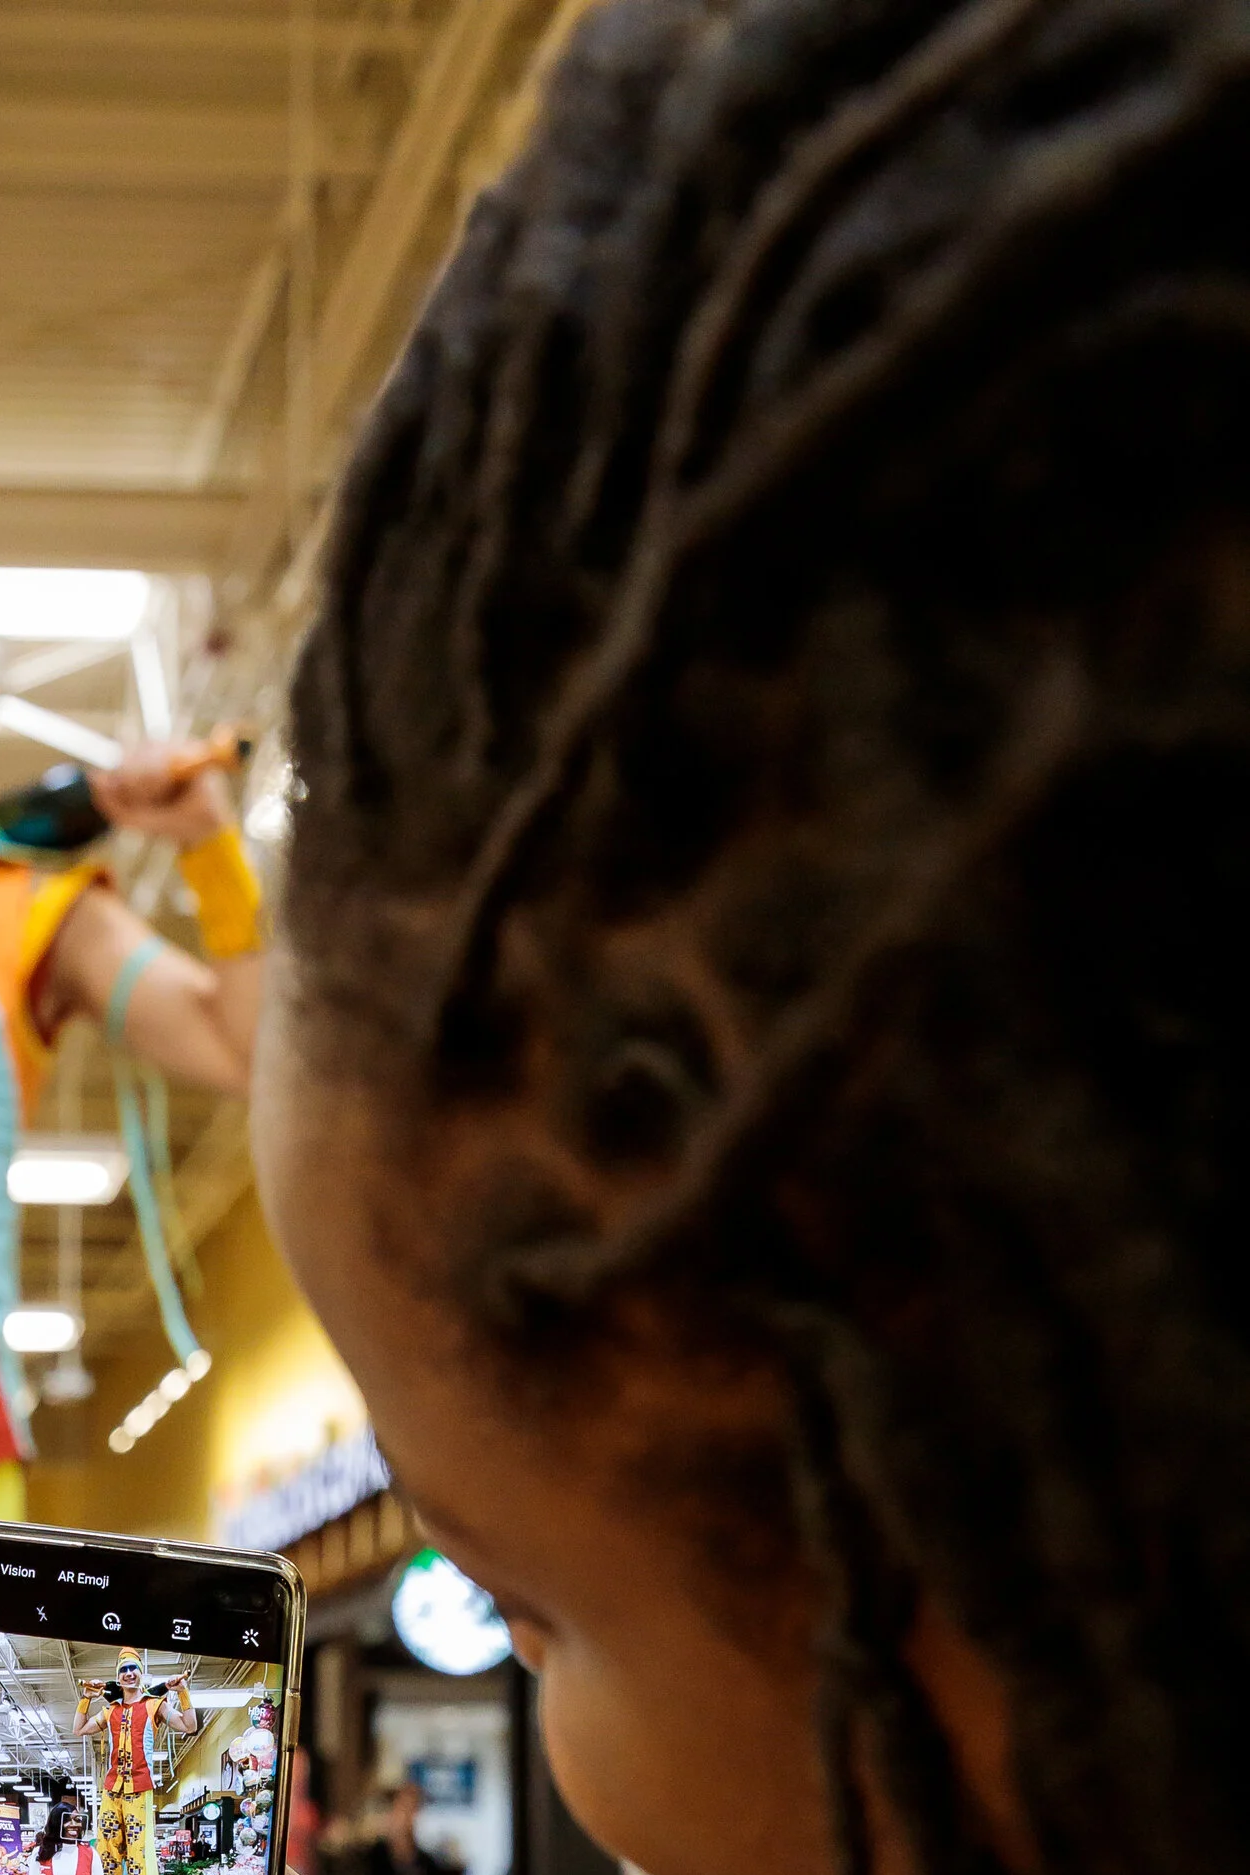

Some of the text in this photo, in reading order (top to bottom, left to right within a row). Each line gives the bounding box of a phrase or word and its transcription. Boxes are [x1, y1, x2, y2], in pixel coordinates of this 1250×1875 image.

[0, 1563, 36, 1578] Vision
[57, 1570, 110, 1589] AR Emoji
[108, 1622, 122, 1631] OFF
[174, 1625, 190, 1635] 3:4
[248, 1706, 266, 1717] HDR
